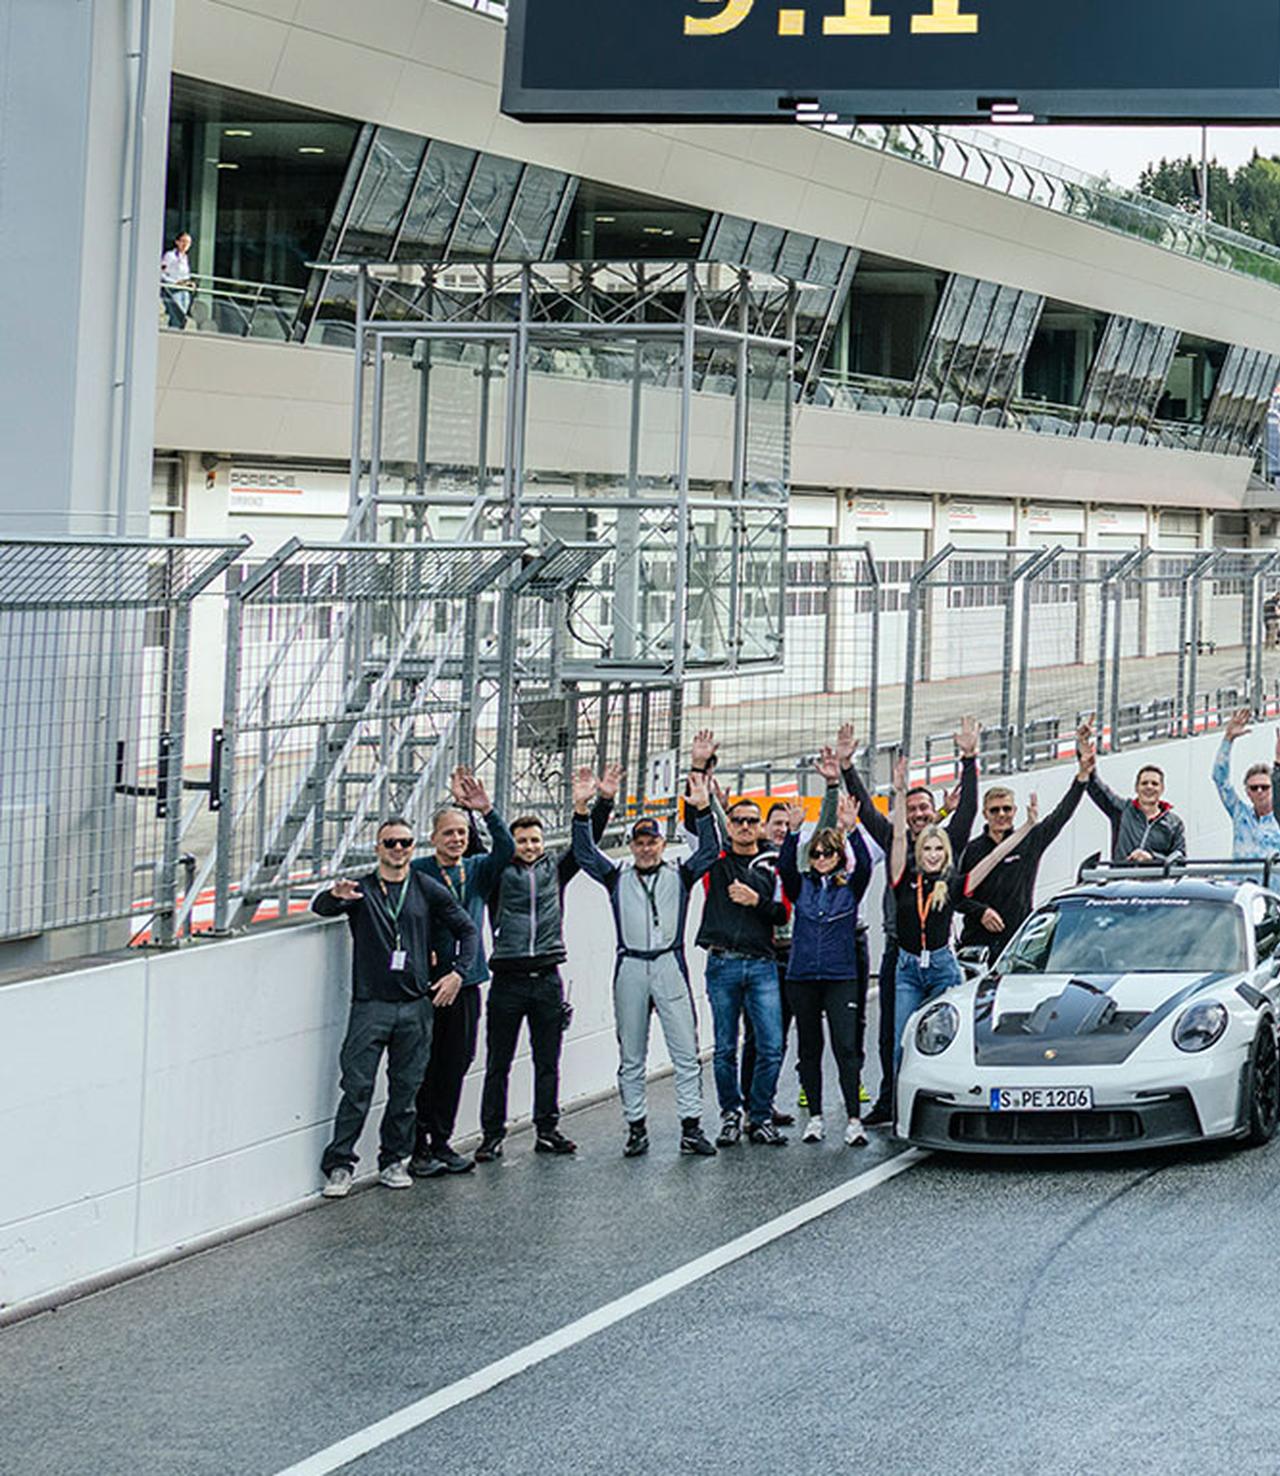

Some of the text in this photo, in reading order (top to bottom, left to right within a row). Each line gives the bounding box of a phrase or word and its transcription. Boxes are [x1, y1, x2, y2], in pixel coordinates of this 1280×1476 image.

[1130, 896, 1190, 906] Experience
[1001, 1090, 1088, 1108] S PE 1206
